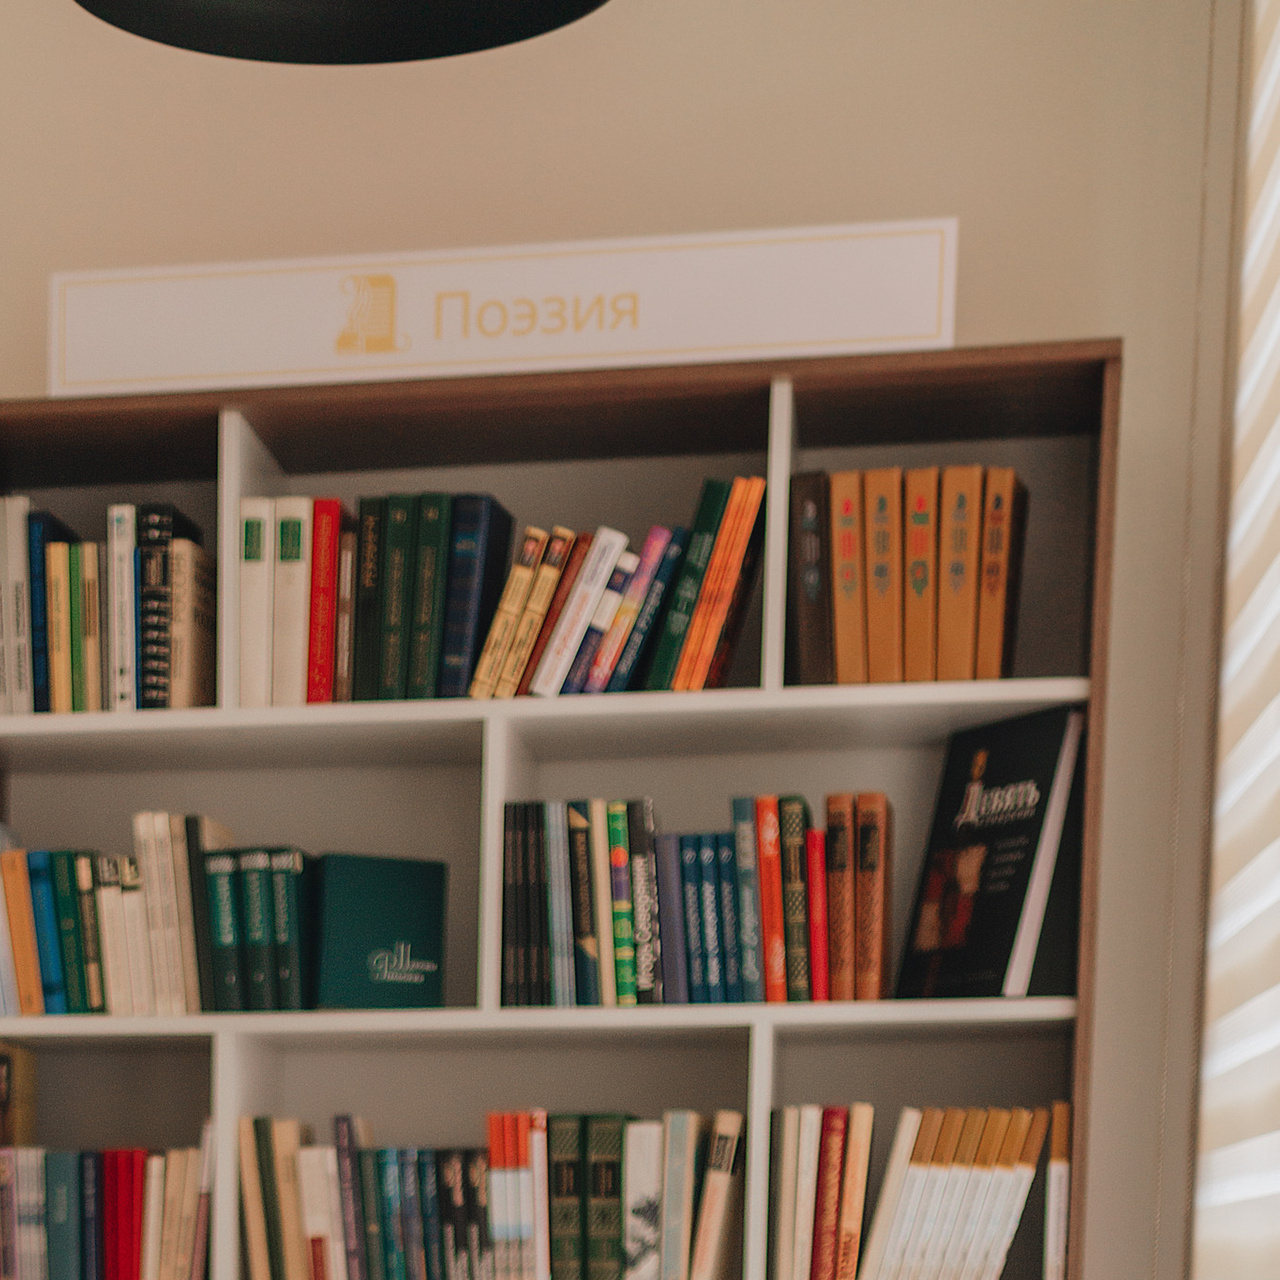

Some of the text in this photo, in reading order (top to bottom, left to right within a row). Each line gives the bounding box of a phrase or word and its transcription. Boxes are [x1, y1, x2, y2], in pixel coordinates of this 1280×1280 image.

[434, 289, 640, 341] Поэзия
[631, 854, 657, 991] Игорь Северянин
